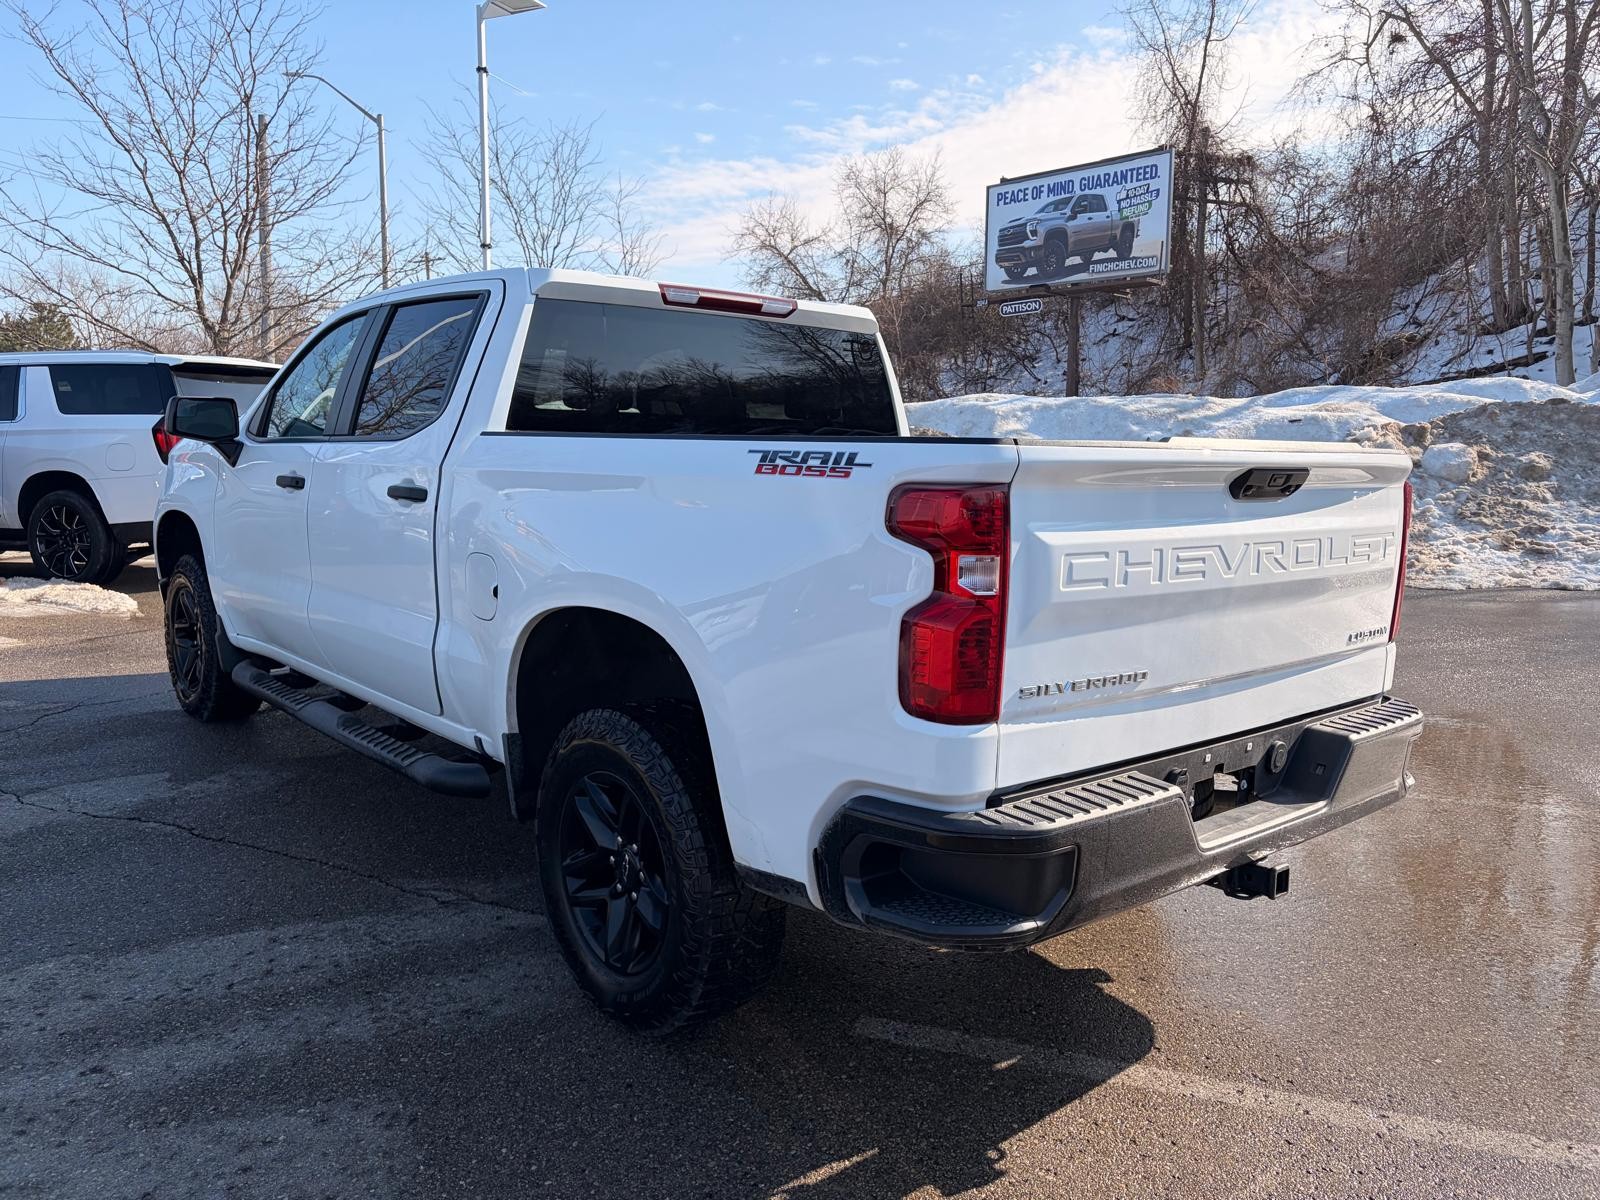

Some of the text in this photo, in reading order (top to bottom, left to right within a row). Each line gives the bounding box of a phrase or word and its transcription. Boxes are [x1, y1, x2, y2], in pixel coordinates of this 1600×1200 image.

[996, 188, 1029, 207] PEACE
[1031, 185, 1045, 200] OF
[1079, 163, 1161, 193] GUARANTEED.
[1128, 184, 1149, 198] 10-DAY
[1120, 191, 1157, 209] NO HASSLE
[1122, 203, 1149, 217] REFUND
[1089, 257, 1157, 274] FINCHCHEV.COM
[1002, 301, 1040, 314] PATTISON
[747, 449, 874, 467] TRAIL
[755, 463, 853, 479] BOSS
[1060, 531, 1395, 592] CHEVROLET
[1347, 625, 1388, 643] CUSTOM
[1018, 670, 1149, 700] SILVERADO
